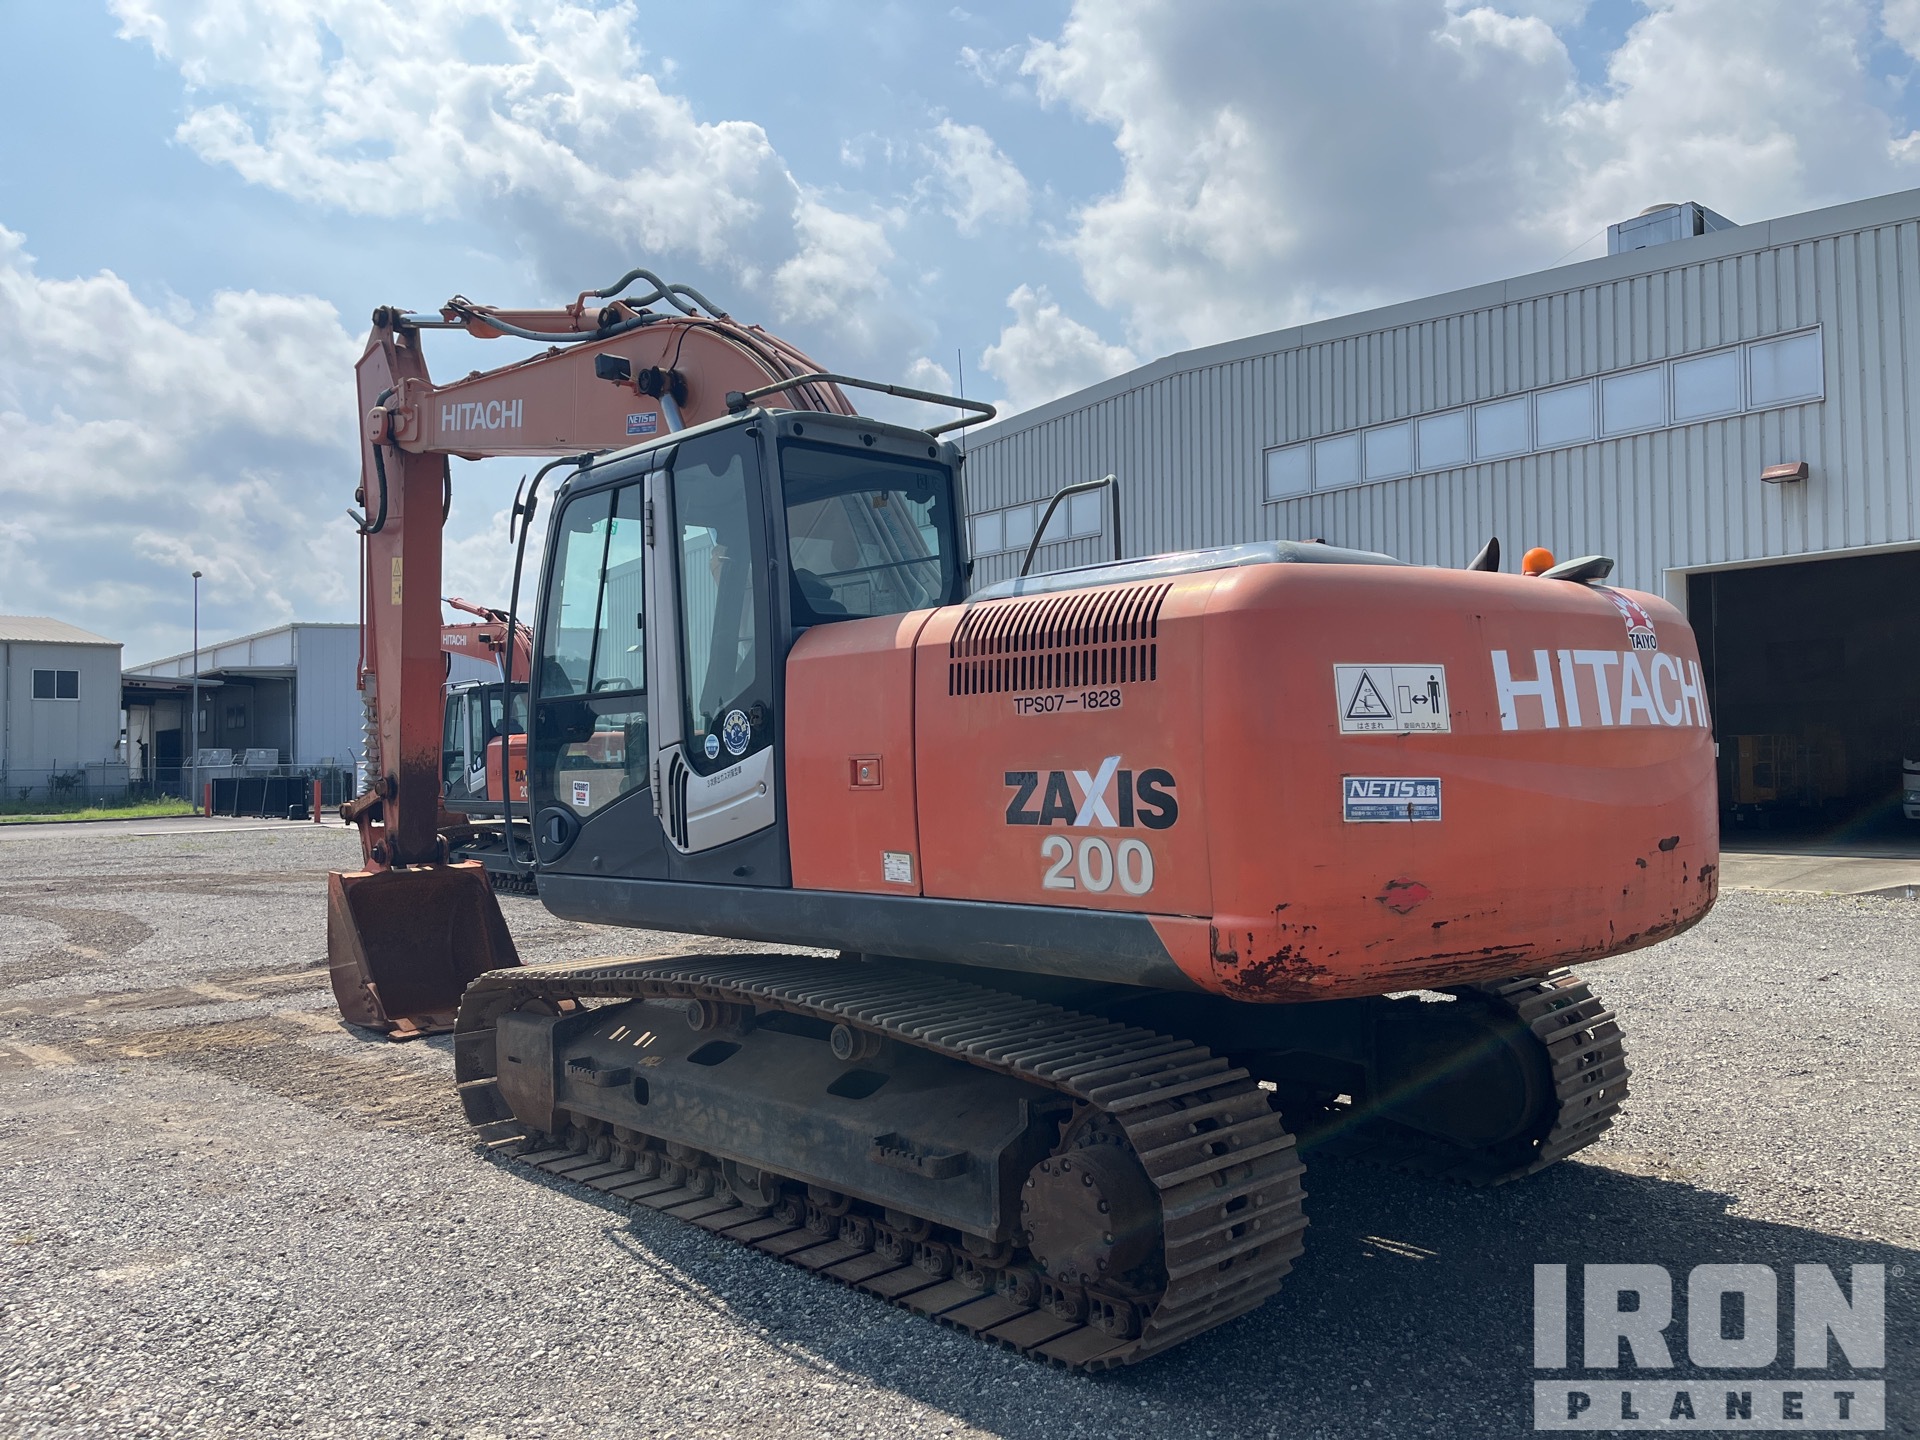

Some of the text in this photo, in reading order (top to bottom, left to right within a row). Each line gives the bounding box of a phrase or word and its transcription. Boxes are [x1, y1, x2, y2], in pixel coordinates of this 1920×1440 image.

[441, 399, 523, 432] HITACHI
[442, 634, 467, 646] HITACHI
[1629, 633, 1657, 650] TAIYO
[1013, 689, 1121, 714] TPS07-1828
[1491, 650, 1707, 731] HITACHI
[1357, 722, 1384, 730] はさまれ
[1005, 755, 1179, 830] ZAXIS
[1349, 781, 1436, 797] NETIS 登録
[1041, 834, 1155, 896] 200
